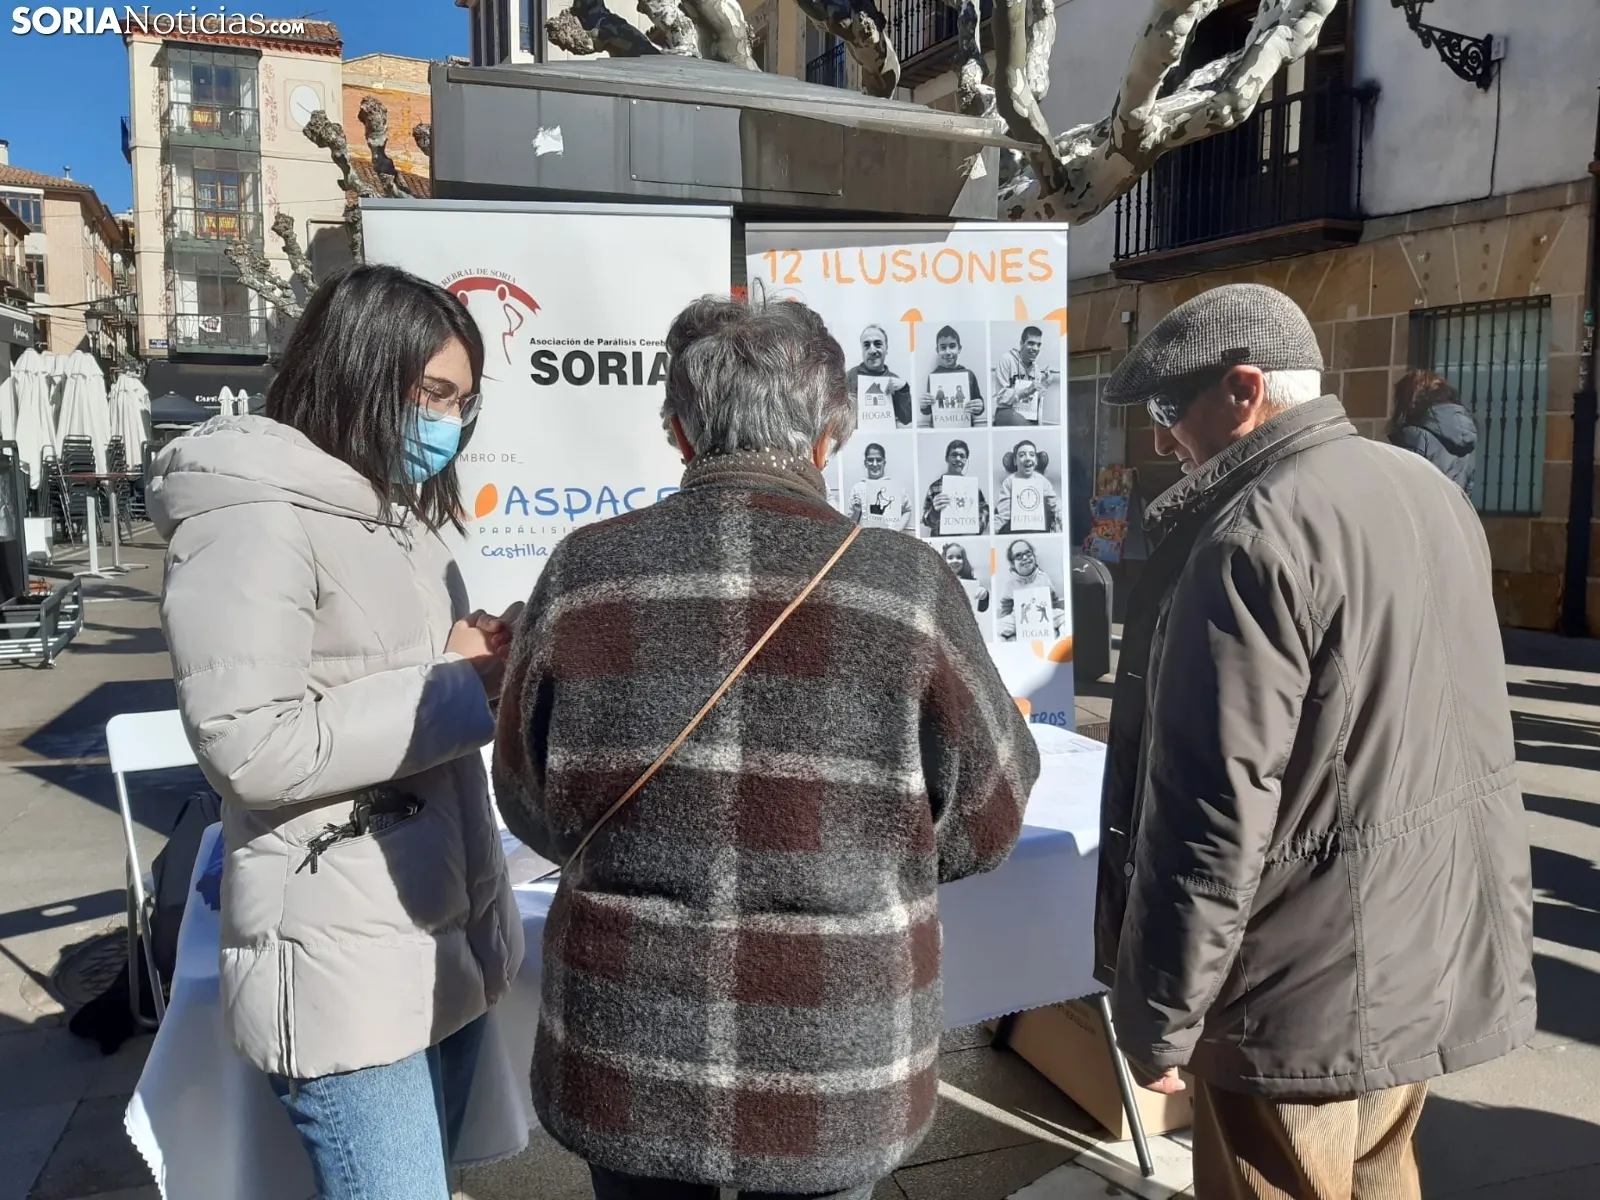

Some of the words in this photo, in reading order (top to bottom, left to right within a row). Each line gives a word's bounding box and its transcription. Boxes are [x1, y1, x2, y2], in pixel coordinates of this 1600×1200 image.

[763, 248, 803, 284] 12
[821, 247, 1053, 285] ILUSIONES
[476, 268, 489, 276] DE
[489, 269, 516, 284] SORIA
[530, 337, 581, 346] Asociación
[583, 338, 595, 346] de
[597, 338, 637, 346] Parálisis
[640, 338, 667, 347] Cereb
[862, 411, 892, 420] HOGAR
[934, 414, 971, 422] FAMILIA
[457, 452, 496, 464] MBRO
[943, 517, 976, 526] JUNTOS
[481, 543, 548, 559] Castilla
[1021, 629, 1050, 638] JUGAR
